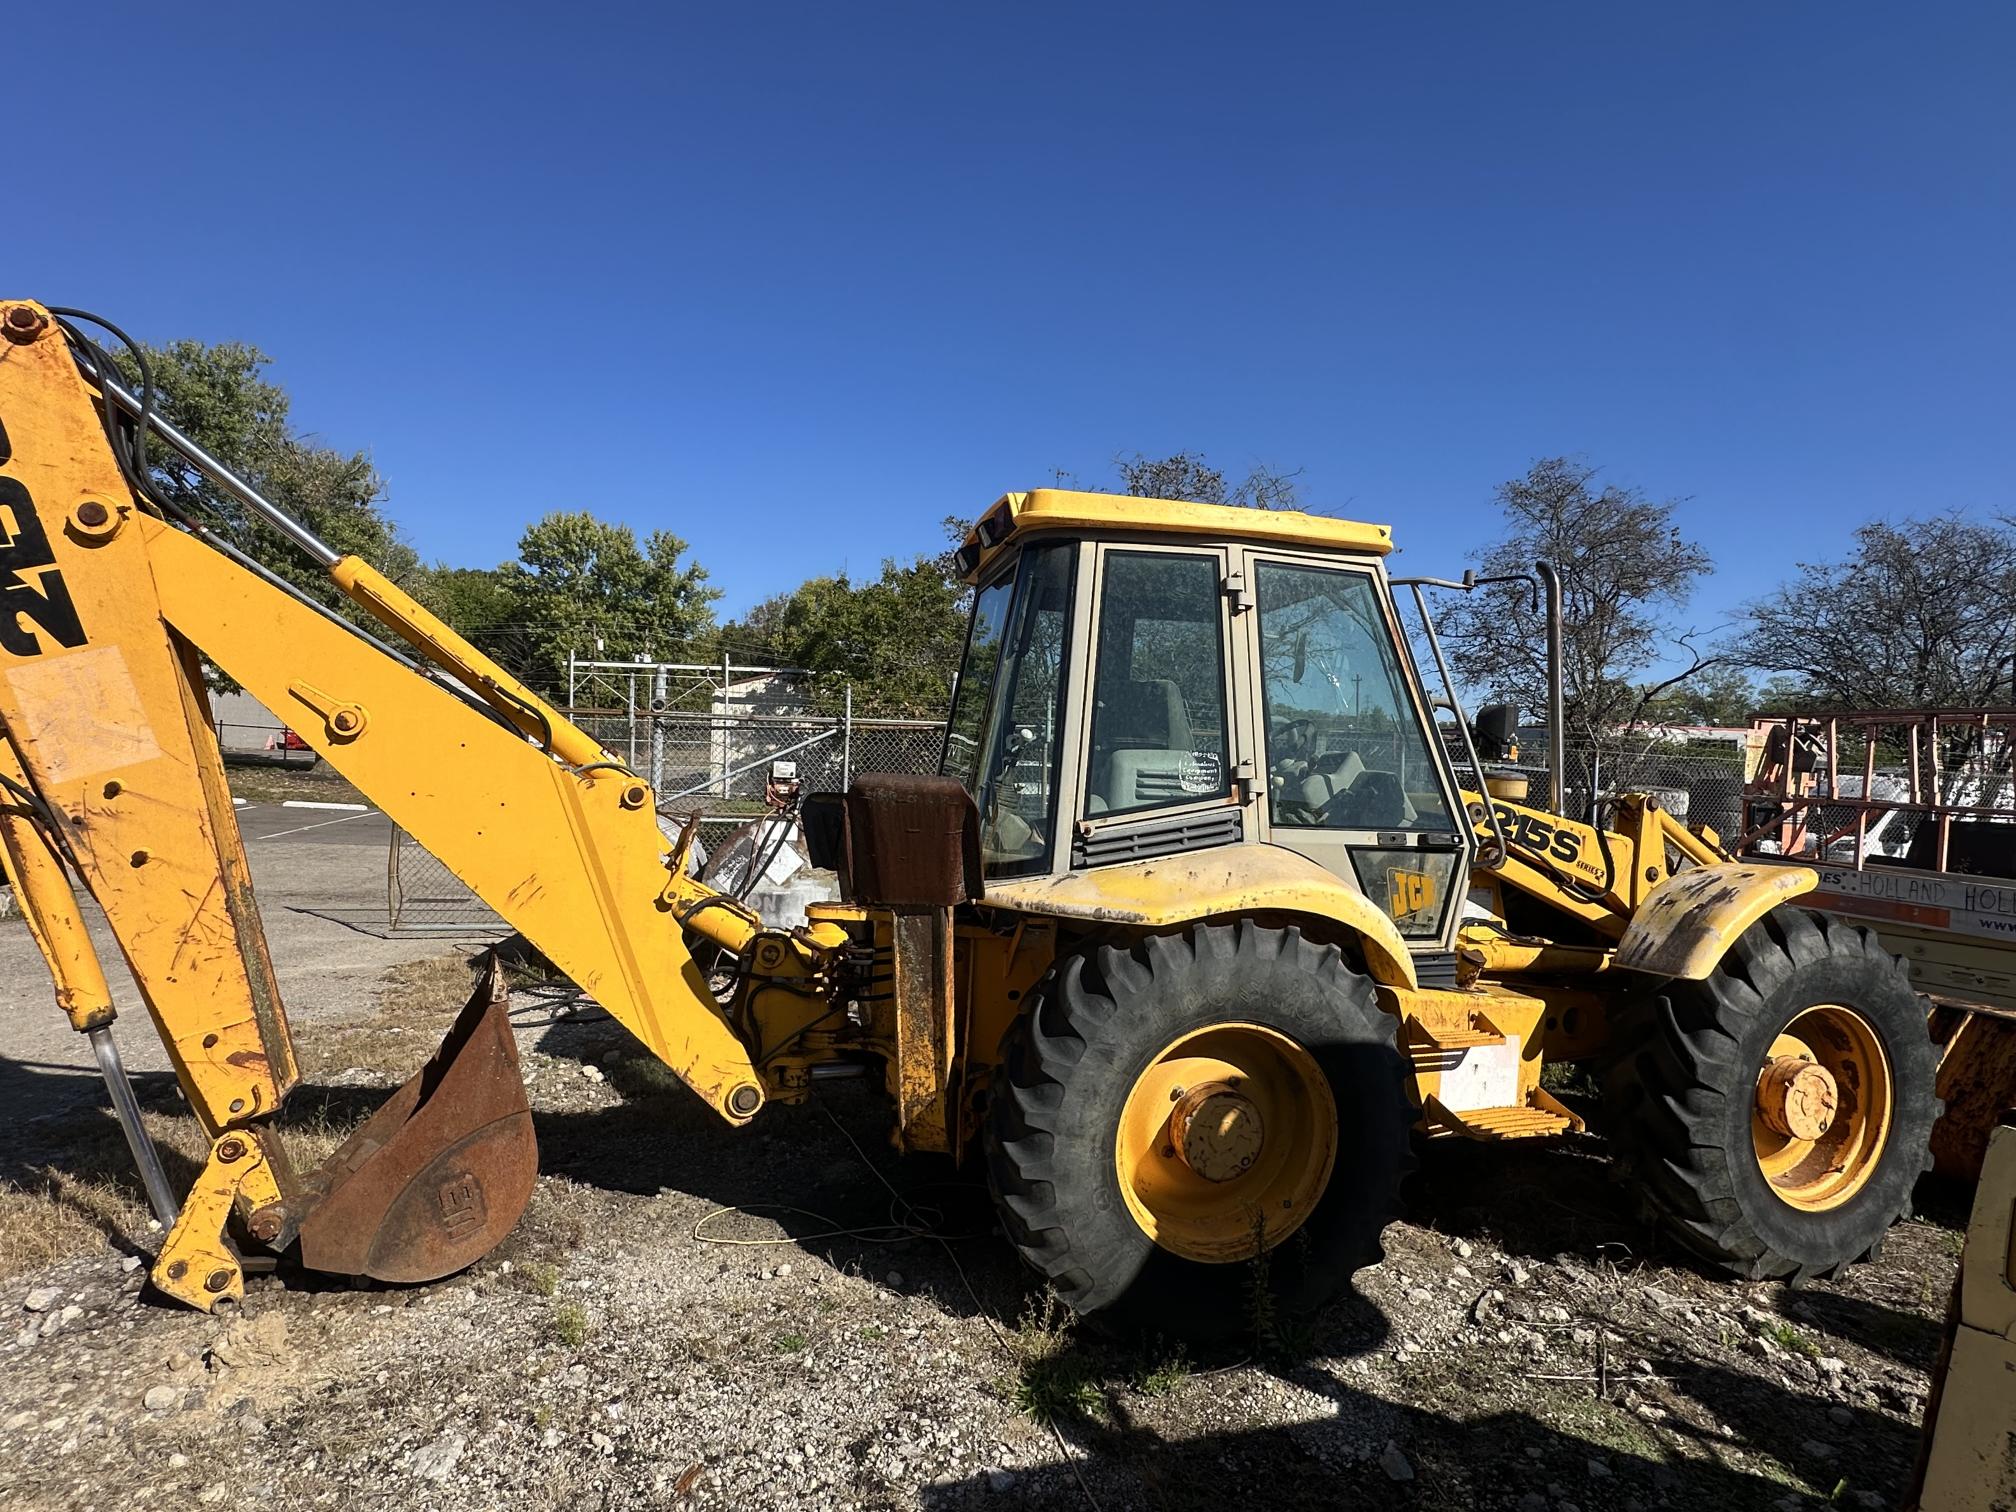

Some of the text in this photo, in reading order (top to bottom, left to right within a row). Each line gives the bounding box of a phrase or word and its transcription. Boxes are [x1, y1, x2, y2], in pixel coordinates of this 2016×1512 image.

[1576, 860, 1599, 875] SERIES
[1818, 872, 1842, 884] ES
[1860, 875, 1946, 903] HOLLAND
